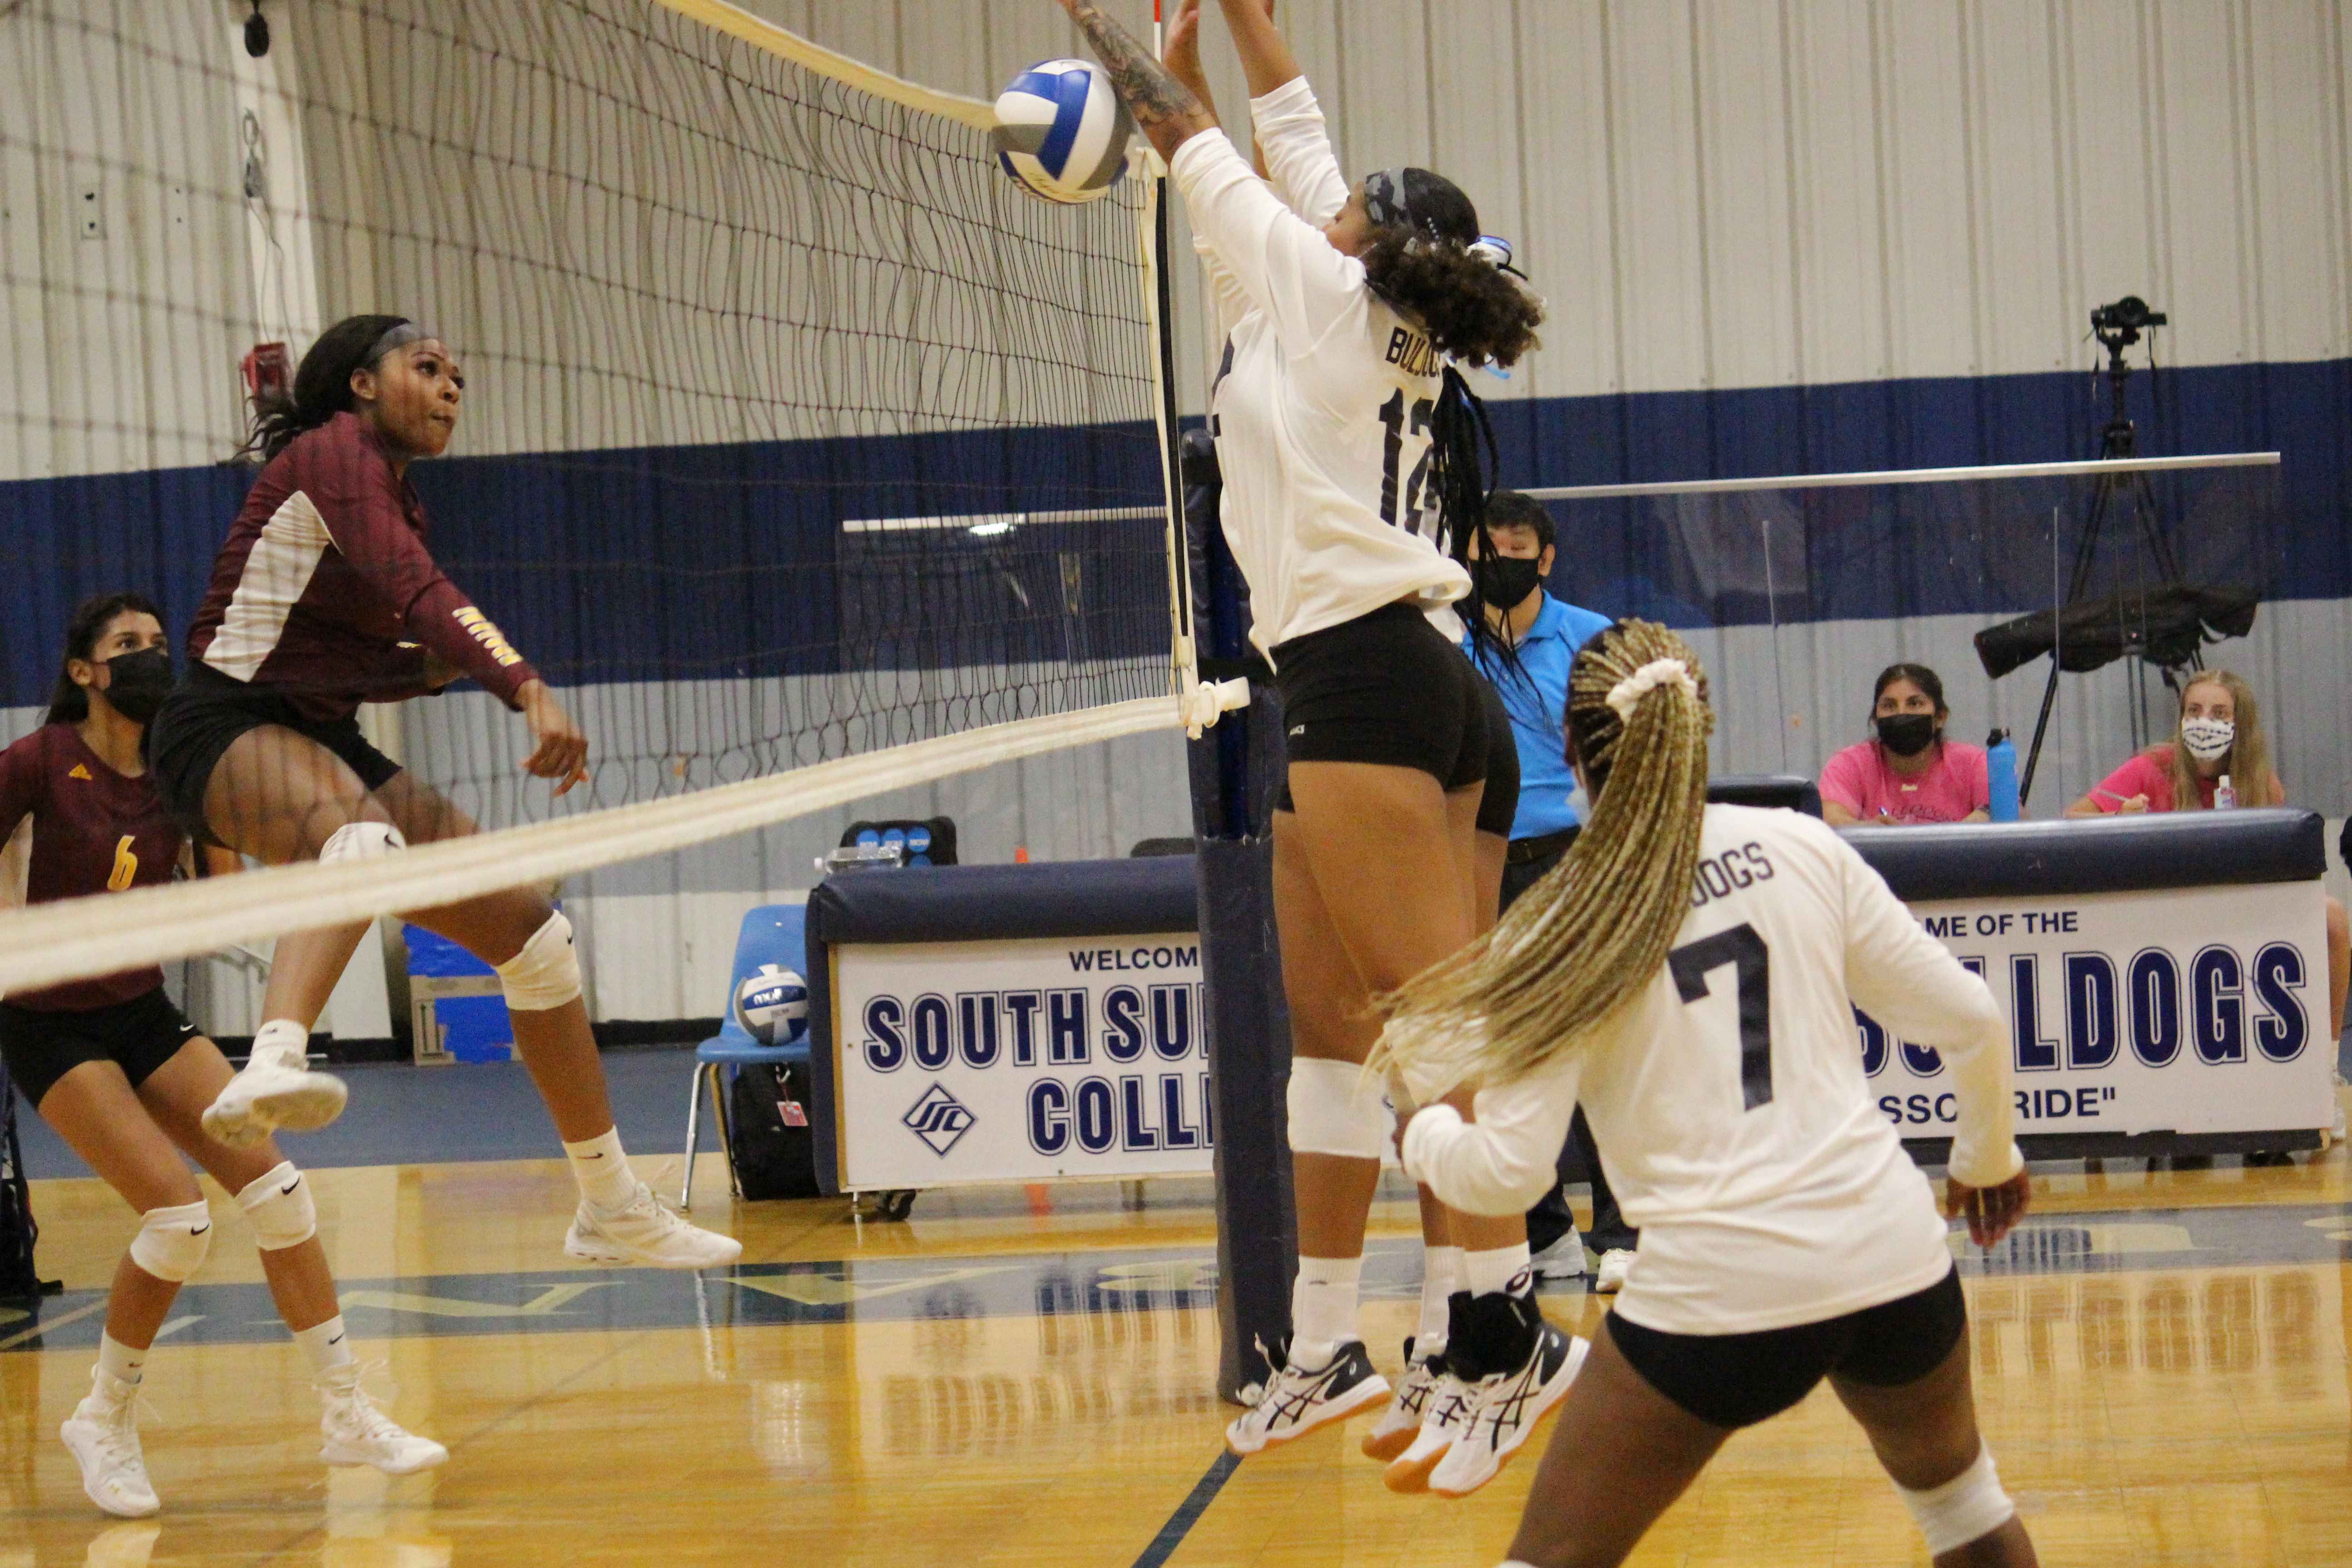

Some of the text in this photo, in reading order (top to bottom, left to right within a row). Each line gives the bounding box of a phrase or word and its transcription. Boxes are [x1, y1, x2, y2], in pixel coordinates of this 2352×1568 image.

[107, 835, 137, 892] 6
[1069, 946, 1198, 971] WELCOM
[1925, 911, 2078, 938] ME OF THE
[862, 982, 1209, 1073] SOUTH SU
[1667, 922, 1773, 1112] 7
[1850, 941, 2309, 1078] LDOGS
[1026, 1072, 1214, 1156] COLL
[2014, 1087, 2115, 1119] RIDE"
